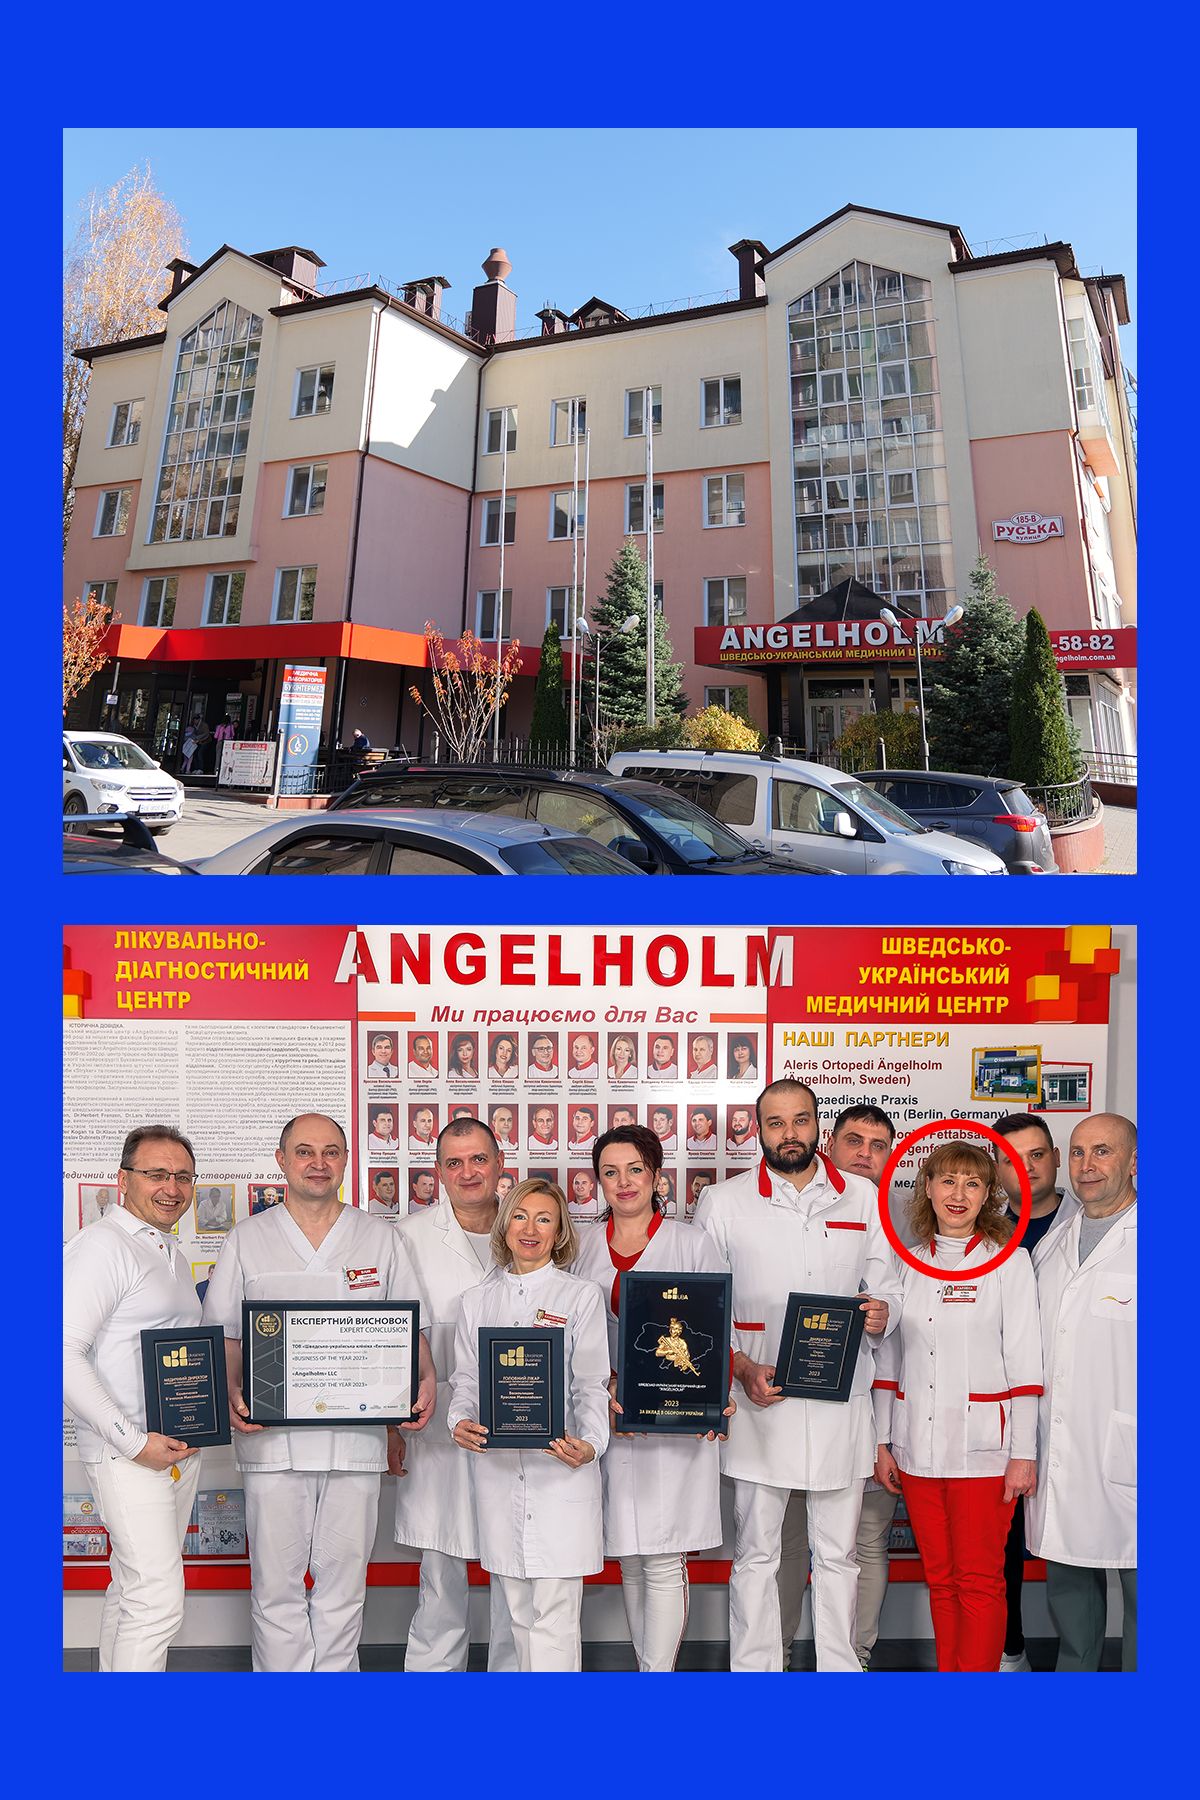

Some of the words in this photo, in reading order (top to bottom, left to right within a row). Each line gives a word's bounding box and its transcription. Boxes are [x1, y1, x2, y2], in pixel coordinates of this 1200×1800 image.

[996, 521, 1059, 537] РУСЬКА
[720, 619, 945, 650] ANGELHOLM
[719, 648, 843, 661] ШВЕДСЬКО-УКРАЇНСЬКИЙ
[845, 647, 905, 660] МЕДИЧНИЙ
[908, 648, 943, 658] ЦЕНТ
[114, 931, 266, 950] ЛІКУВАЛЬНО-
[882, 937, 1011, 958] ШВЕДСЬКО-
[334, 931, 795, 988] ANGELHOLM
[115, 959, 309, 982] ДІАГНОСТИЧНИЙ
[859, 963, 1010, 984] УКРАЇНСЬКИЙ
[116, 991, 191, 1012] ЦЕНТР
[806, 992, 930, 1016] МЕДИЧНИЙ
[937, 996, 1009, 1016] ЦЕНТР
[431, 1005, 463, 1024] Ми
[472, 1008, 596, 1027] працюємо
[604, 1007, 646, 1024] для
[656, 1006, 698, 1023] Вас
[783, 1031, 834, 1047] НАШІ
[845, 1031, 949, 1047] ПАРТНЕРИ
[784, 1059, 818, 1070] Aleris
[821, 1059, 874, 1072] Ortopedi
[878, 1057, 943, 1072] Ängelholm
[859, 1074, 911, 1087] Sweden)
[817, 1094, 877, 1106] paedische
[881, 1095, 918, 1105] Praxis
[904, 1109, 946, 1121] (Berlin,
[950, 1109, 1009, 1121] Germany)
[200, 1171, 252, 1180] створений
[267, 1173, 288, 1181] спри
[291, 1316, 354, 1325] ЕКСПЕРТНИЙ
[355, 1317, 408, 1325] ВИСНОВОК
